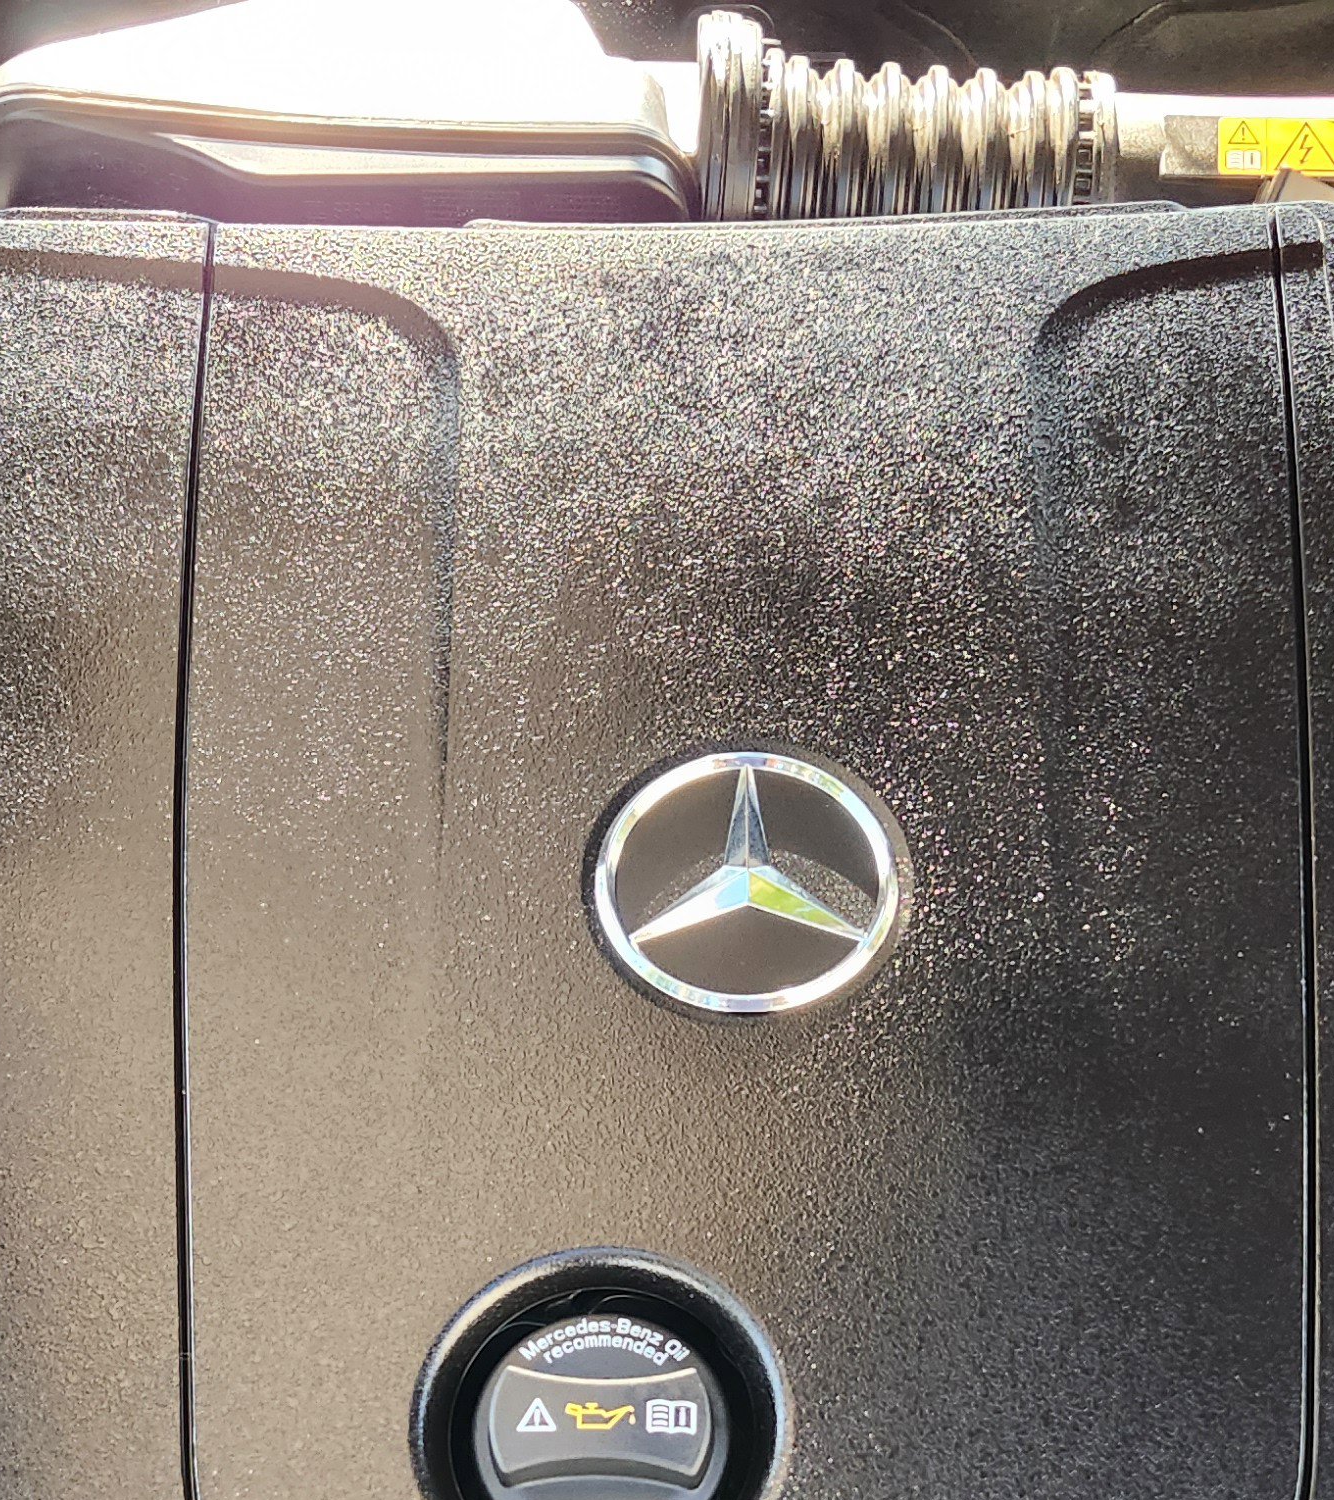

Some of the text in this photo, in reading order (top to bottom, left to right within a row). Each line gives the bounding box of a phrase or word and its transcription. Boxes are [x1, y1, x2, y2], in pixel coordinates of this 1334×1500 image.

[518, 1317, 691, 1362] Mercedes-Benz Oil
[542, 1334, 669, 1367] recommended
